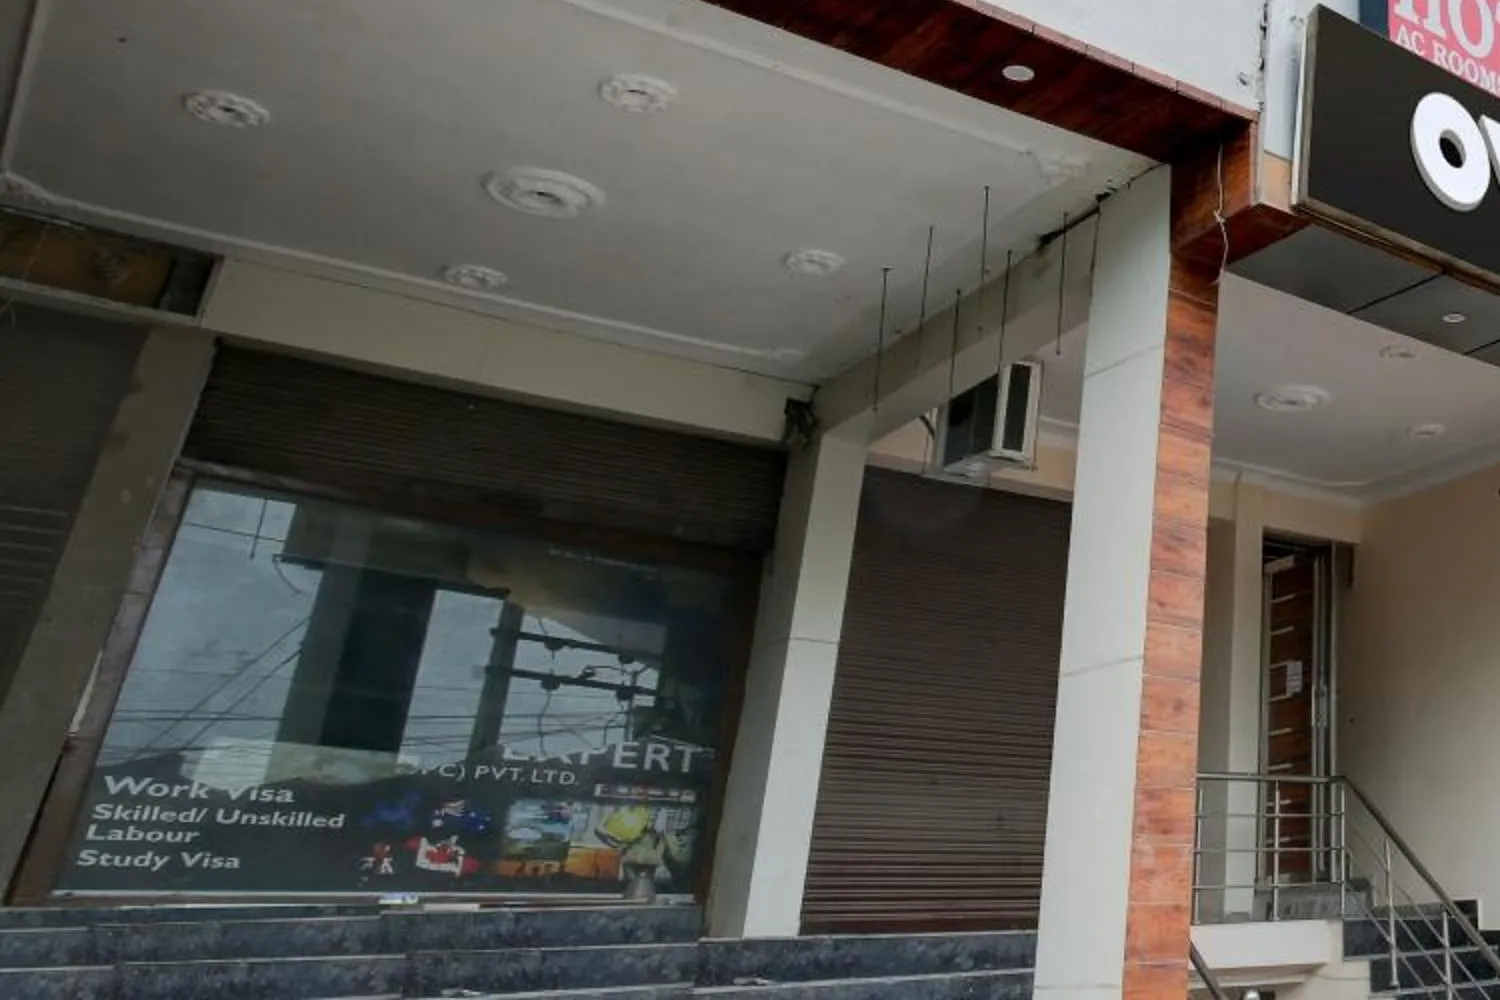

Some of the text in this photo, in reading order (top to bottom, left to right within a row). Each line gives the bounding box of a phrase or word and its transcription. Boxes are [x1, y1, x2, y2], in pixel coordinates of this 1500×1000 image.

[1395, 25, 1425, 56] AC
[474, 764, 525, 782] PVT.
[530, 768, 580, 787] LTD.
[103, 774, 296, 804] Work Visa
[91, 803, 346, 829] Skilled/ Unskilled
[84, 823, 201, 844] Labour
[76, 849, 241, 872] Study Visa
